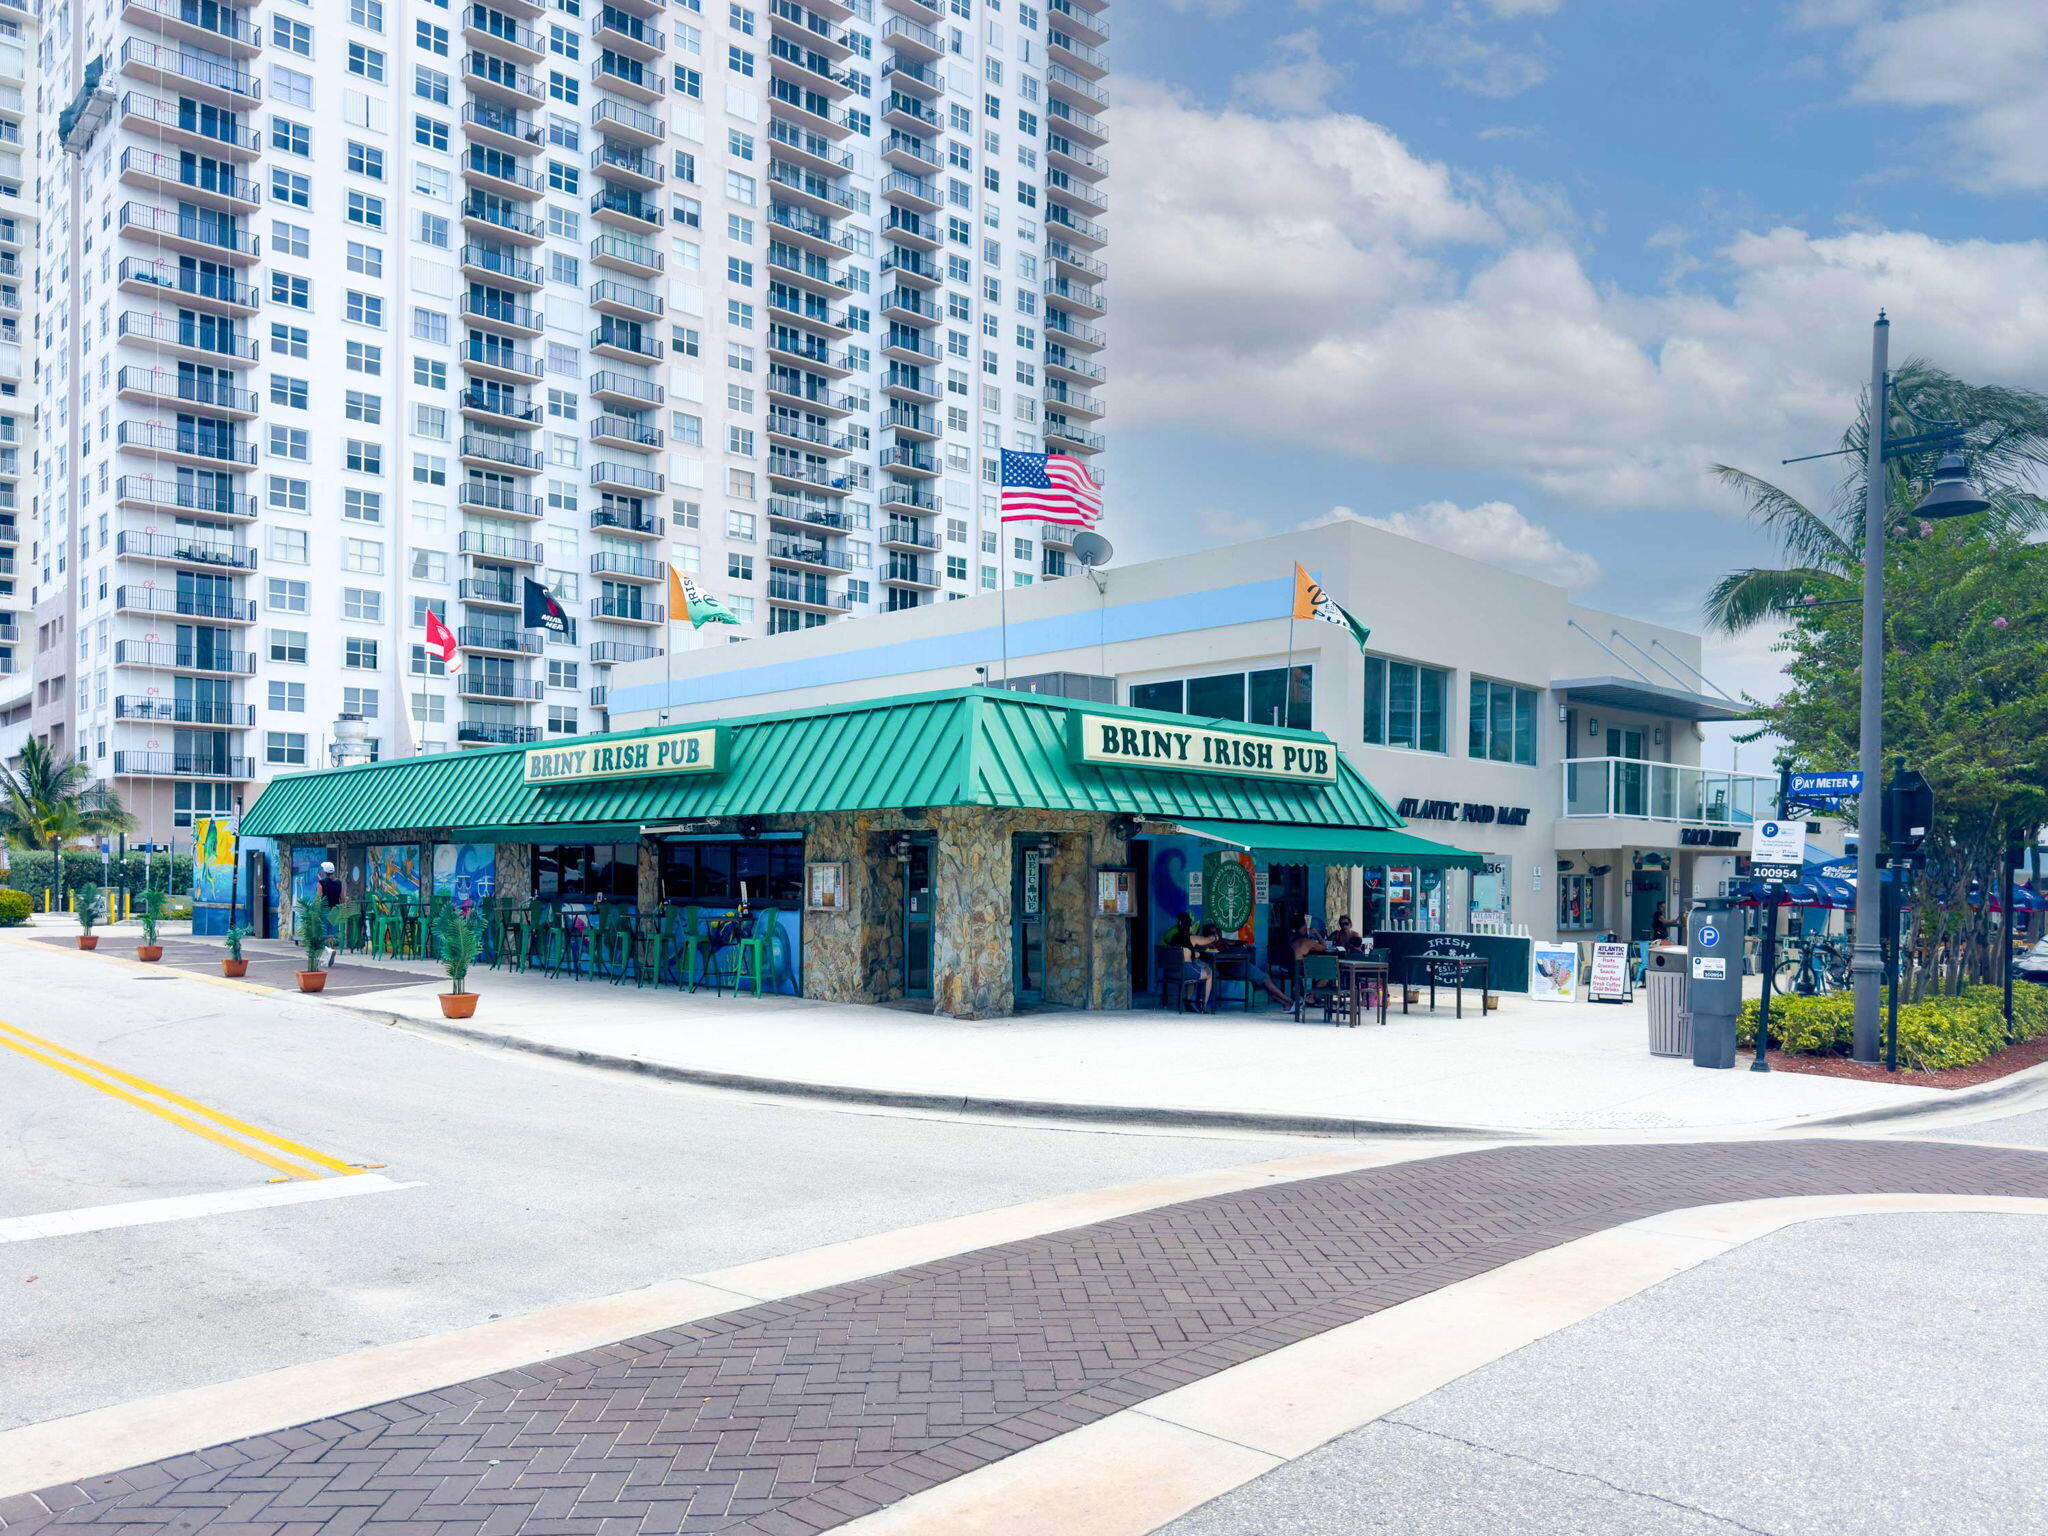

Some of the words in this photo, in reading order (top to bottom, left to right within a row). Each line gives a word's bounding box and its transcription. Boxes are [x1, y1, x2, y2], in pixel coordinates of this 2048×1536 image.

[683, 576, 702, 607] IRIS
[541, 614, 563, 625] MIA
[545, 621, 564, 631] HEA
[531, 750, 587, 777] BRINY
[593, 744, 649, 771] IRISH
[657, 738, 700, 765] PUB
[1101, 725, 1192, 760] BRINY
[1203, 737, 1273, 769] IRISH
[1283, 746, 1328, 774] PUB
[1795, 778, 1815, 789] PAY
[1816, 778, 1848, 788] METER
[1397, 797, 1460, 822] ATLANTIC
[1461, 803, 1495, 823] FOOD
[1026, 854, 1037, 910] WELCME
[1753, 868, 1797, 878] 100954
[1428, 937, 1471, 949] IRISH
